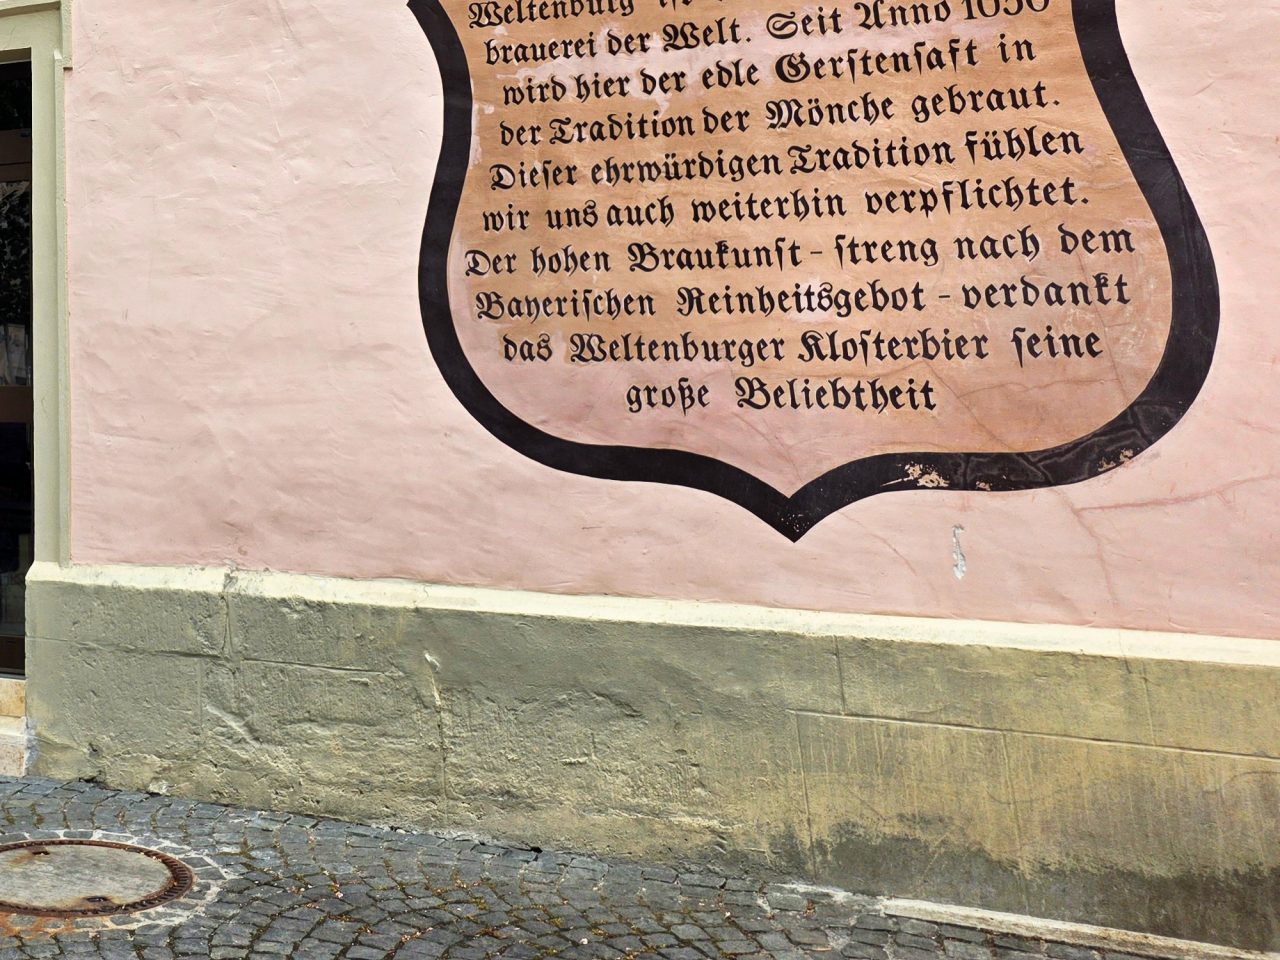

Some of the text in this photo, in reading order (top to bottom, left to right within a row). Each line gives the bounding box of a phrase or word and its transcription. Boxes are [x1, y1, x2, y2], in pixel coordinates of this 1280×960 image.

[483, 31, 597, 66] brauerei
[606, 31, 651, 57] der
[662, 16, 751, 52] Welt.
[766, 6, 843, 40] Seit
[502, 75, 567, 106] wird
[573, 72, 631, 104] hier
[639, 68, 686, 96] der
[701, 58, 760, 90] edle
[997, 33, 1037, 64] in
[499, 80, 1060, 147] der Tradition der Mönche gebraut.
[591, 149, 784, 187] ehrwürdigen
[787, 136, 956, 175] Tradition
[964, 125, 1085, 164] fühlen
[482, 176, 1089, 232] wir uns auch weiterhin verpflichtet.
[464, 249, 517, 277] Der
[530, 244, 611, 275] hohen
[953, 224, 1040, 262] nach
[1057, 223, 1136, 255] dem
[676, 279, 926, 318] Reinheitsgebot
[961, 272, 1131, 310] verdankt
[502, 333, 553, 362] das
[569, 331, 785, 368] Weltenburger
[626, 376, 937, 415] große Beliebtheit
